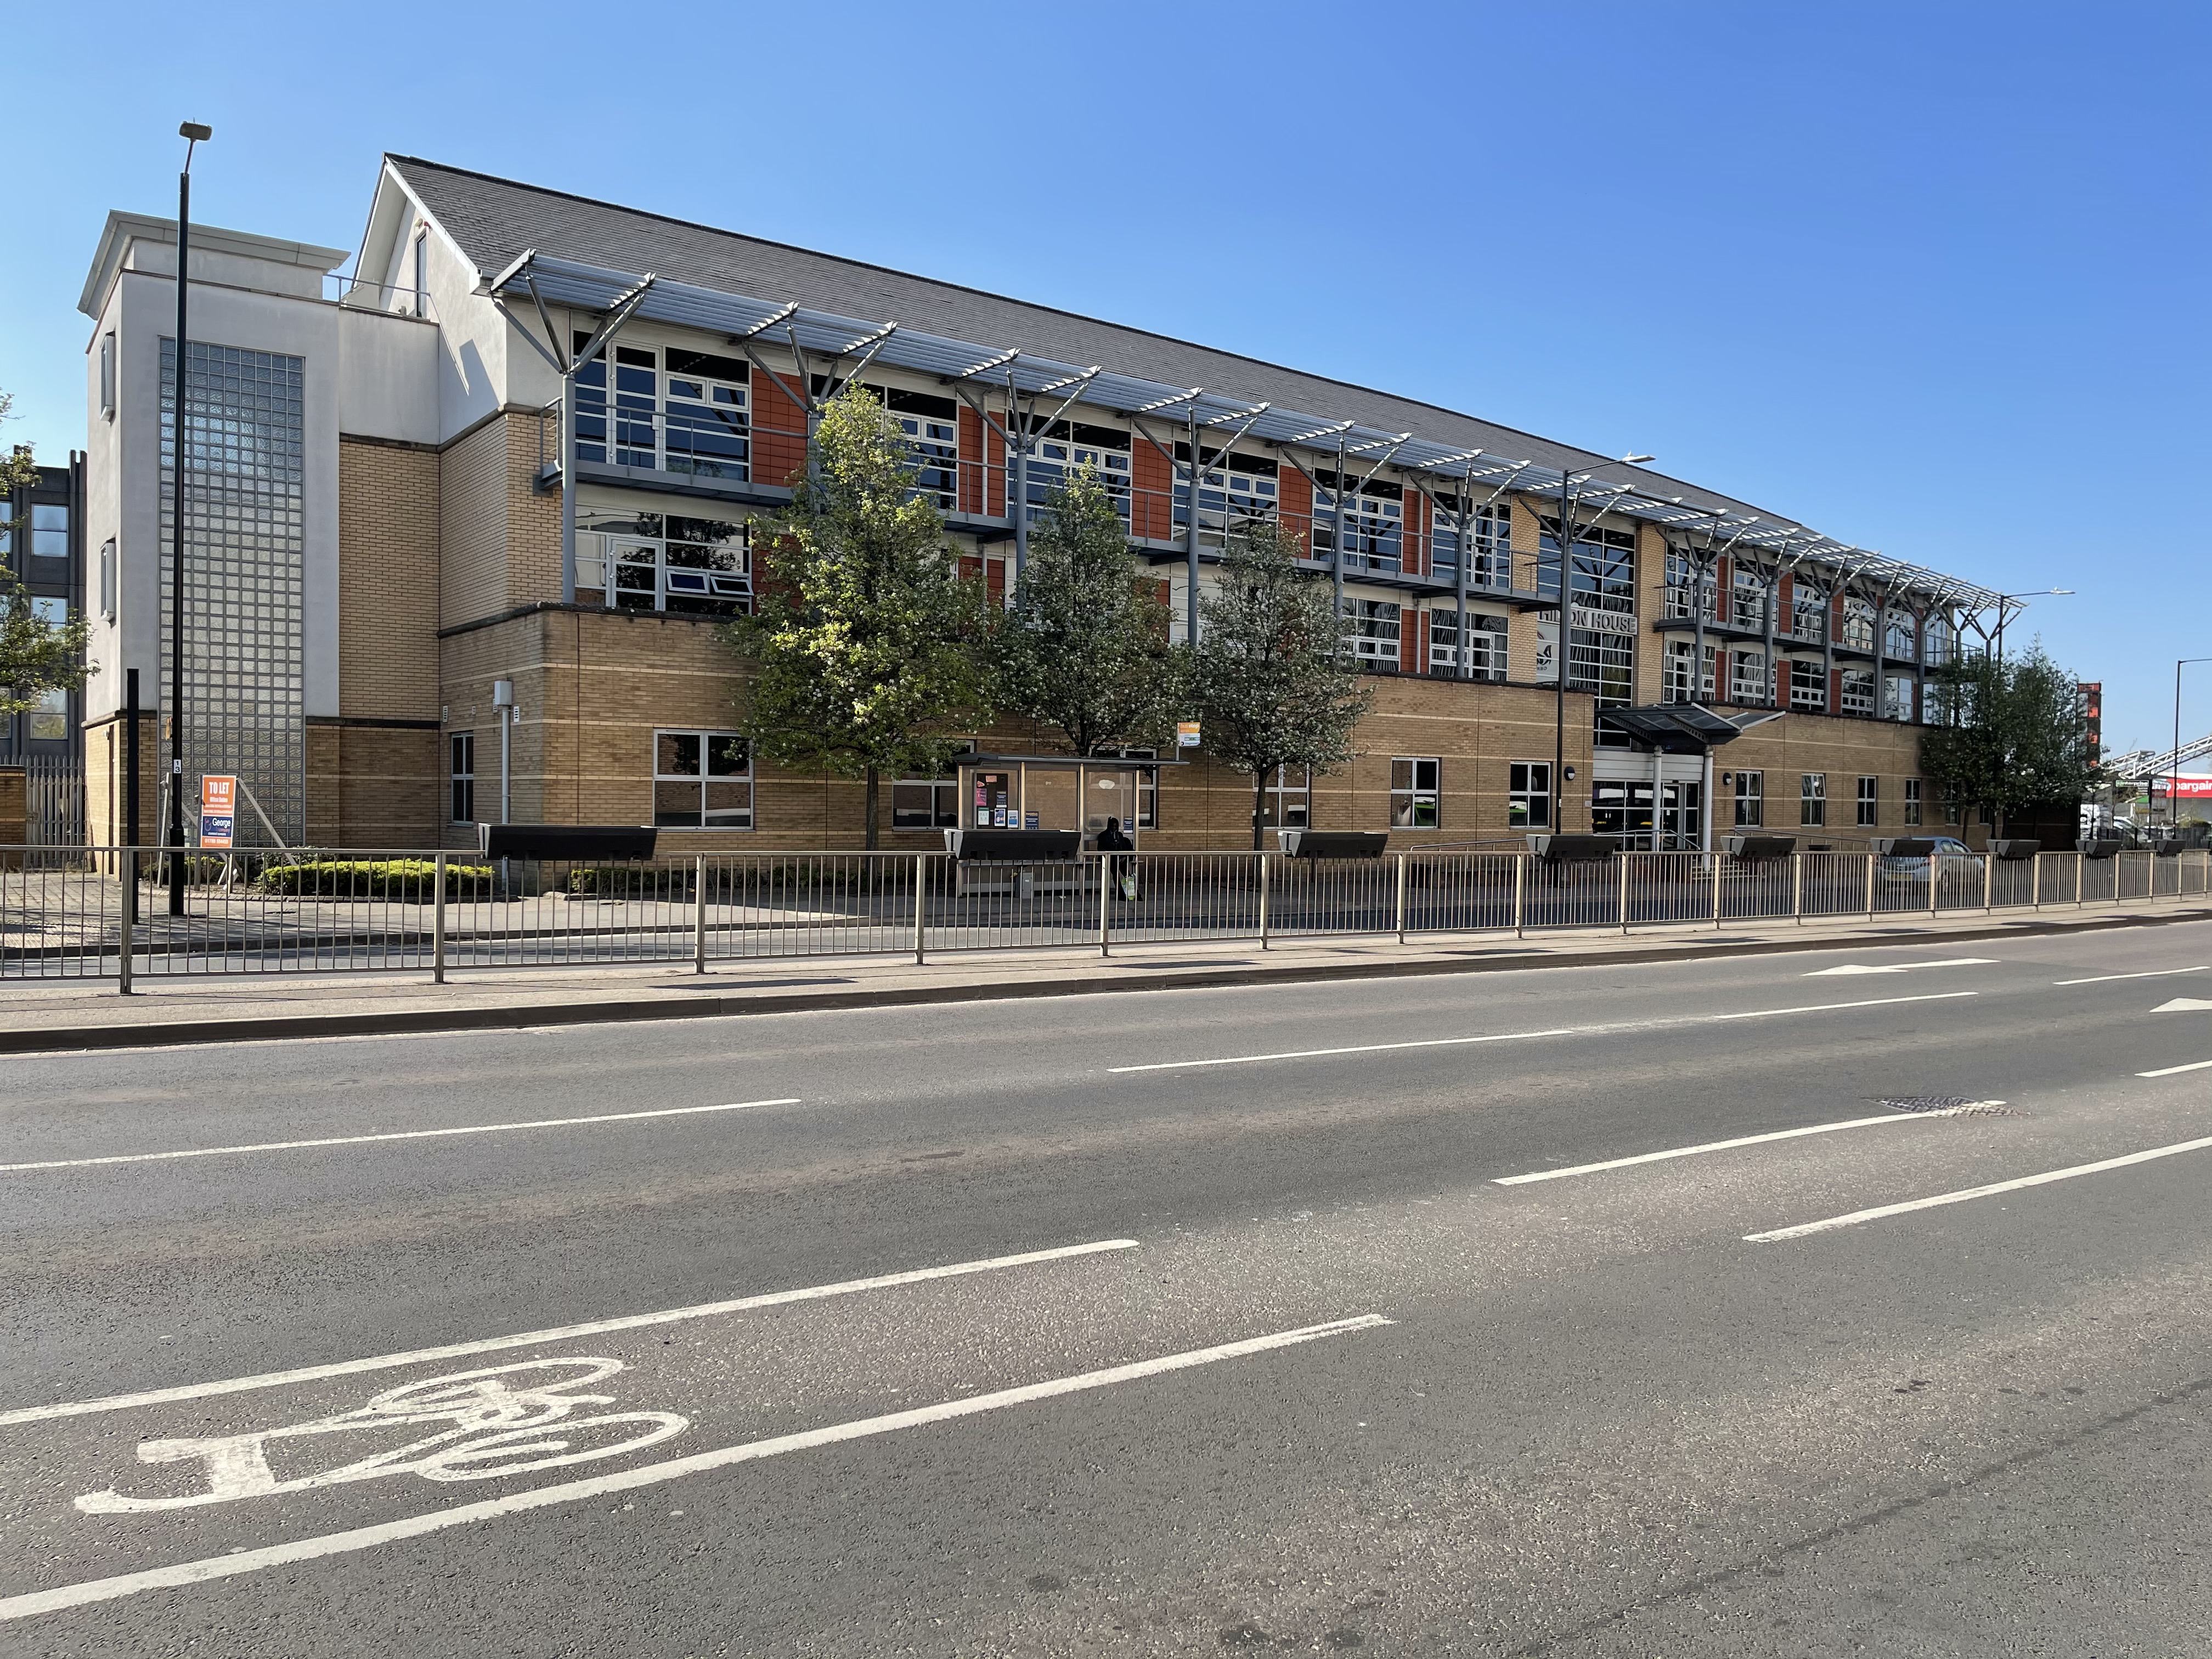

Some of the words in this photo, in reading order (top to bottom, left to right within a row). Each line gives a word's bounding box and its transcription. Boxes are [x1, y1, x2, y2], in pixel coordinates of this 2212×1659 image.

[1592, 612, 1636, 633] HOUSE
[209, 782, 218, 794] TO
[219, 782, 230, 794] LET
[212, 817, 230, 828] George
